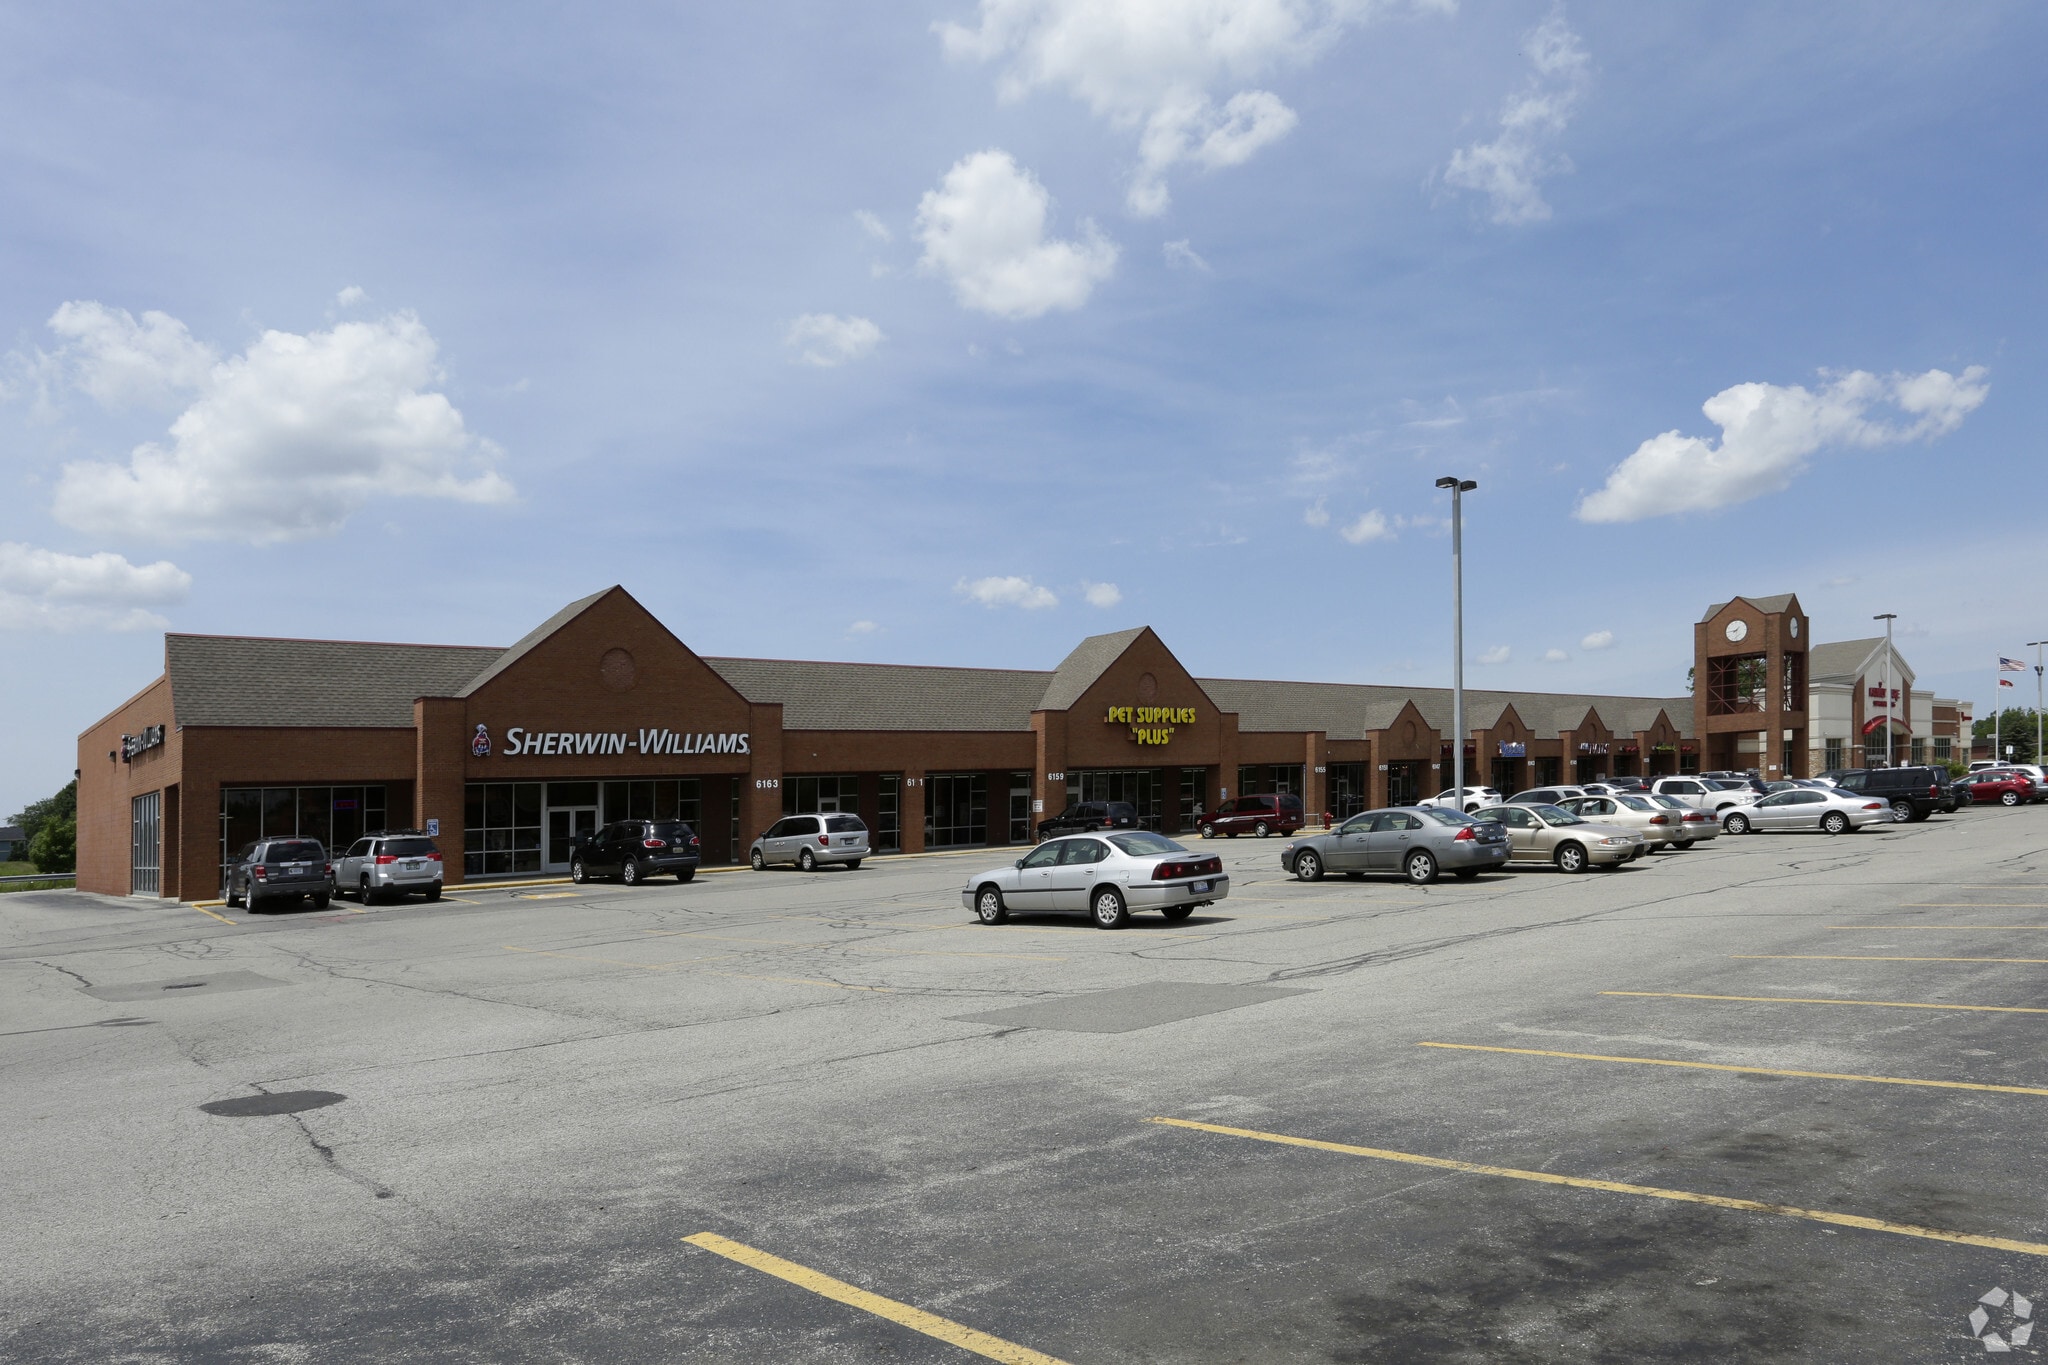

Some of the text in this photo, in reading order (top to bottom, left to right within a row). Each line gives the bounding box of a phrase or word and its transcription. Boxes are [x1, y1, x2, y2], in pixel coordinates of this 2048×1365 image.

[1109, 706, 1195, 723] PET SUPPLIES
[503, 727, 750, 756] SHERWIN-WILLIAMS
[1048, 772, 1064, 781] 6159
[756, 779, 778, 789] 6163
